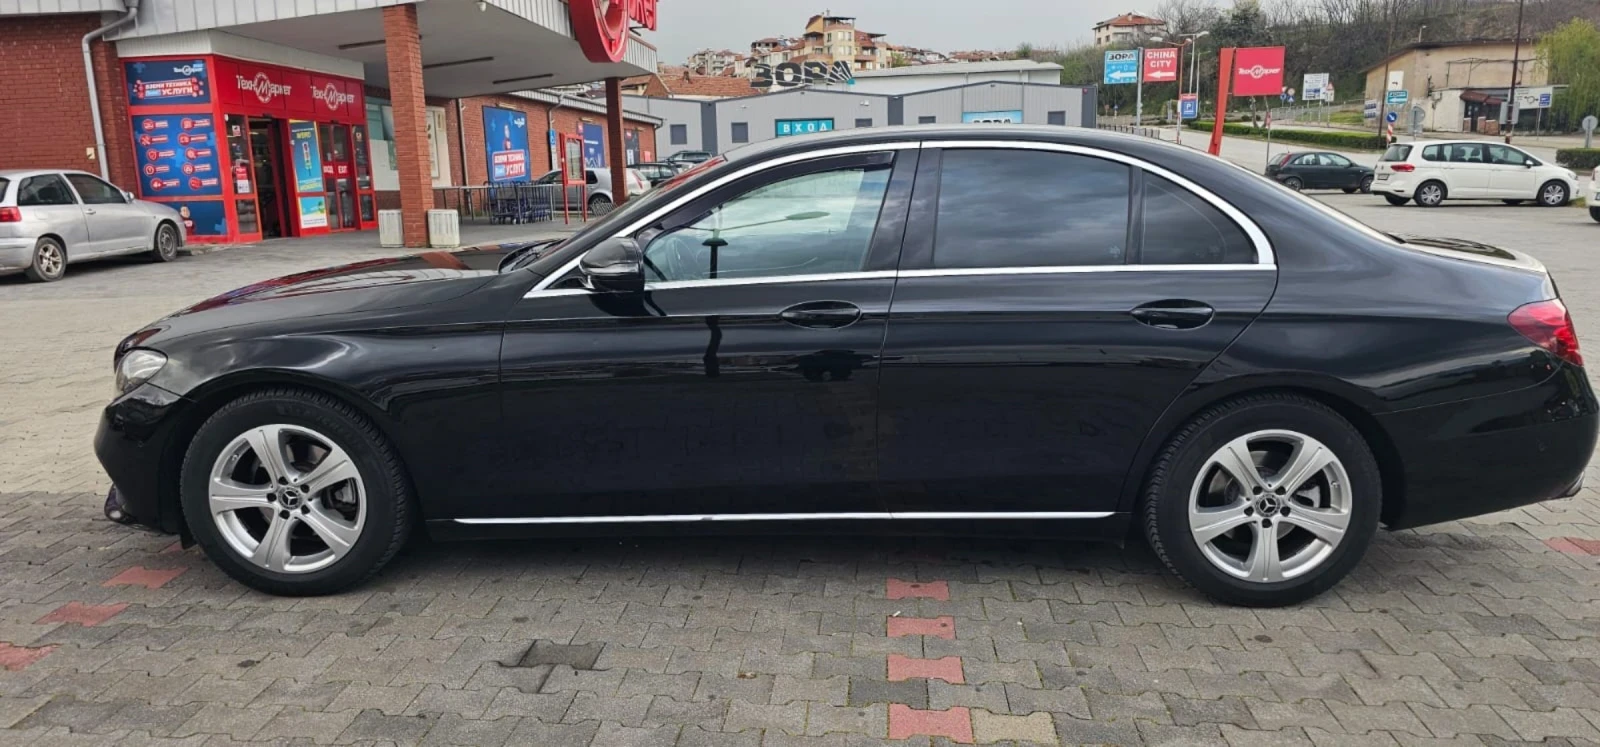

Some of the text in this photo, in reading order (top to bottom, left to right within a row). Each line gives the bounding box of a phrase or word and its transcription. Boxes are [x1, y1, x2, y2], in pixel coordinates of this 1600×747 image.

[1147, 51, 1175, 59] CHINA
[1150, 60, 1171, 68] CITY
[750, 61, 852, 87] ЗОРА
[162, 86, 193, 96] УСЛУГИ
[783, 123, 828, 133] ВХОД
[506, 163, 525, 176] УСЛУГИ
